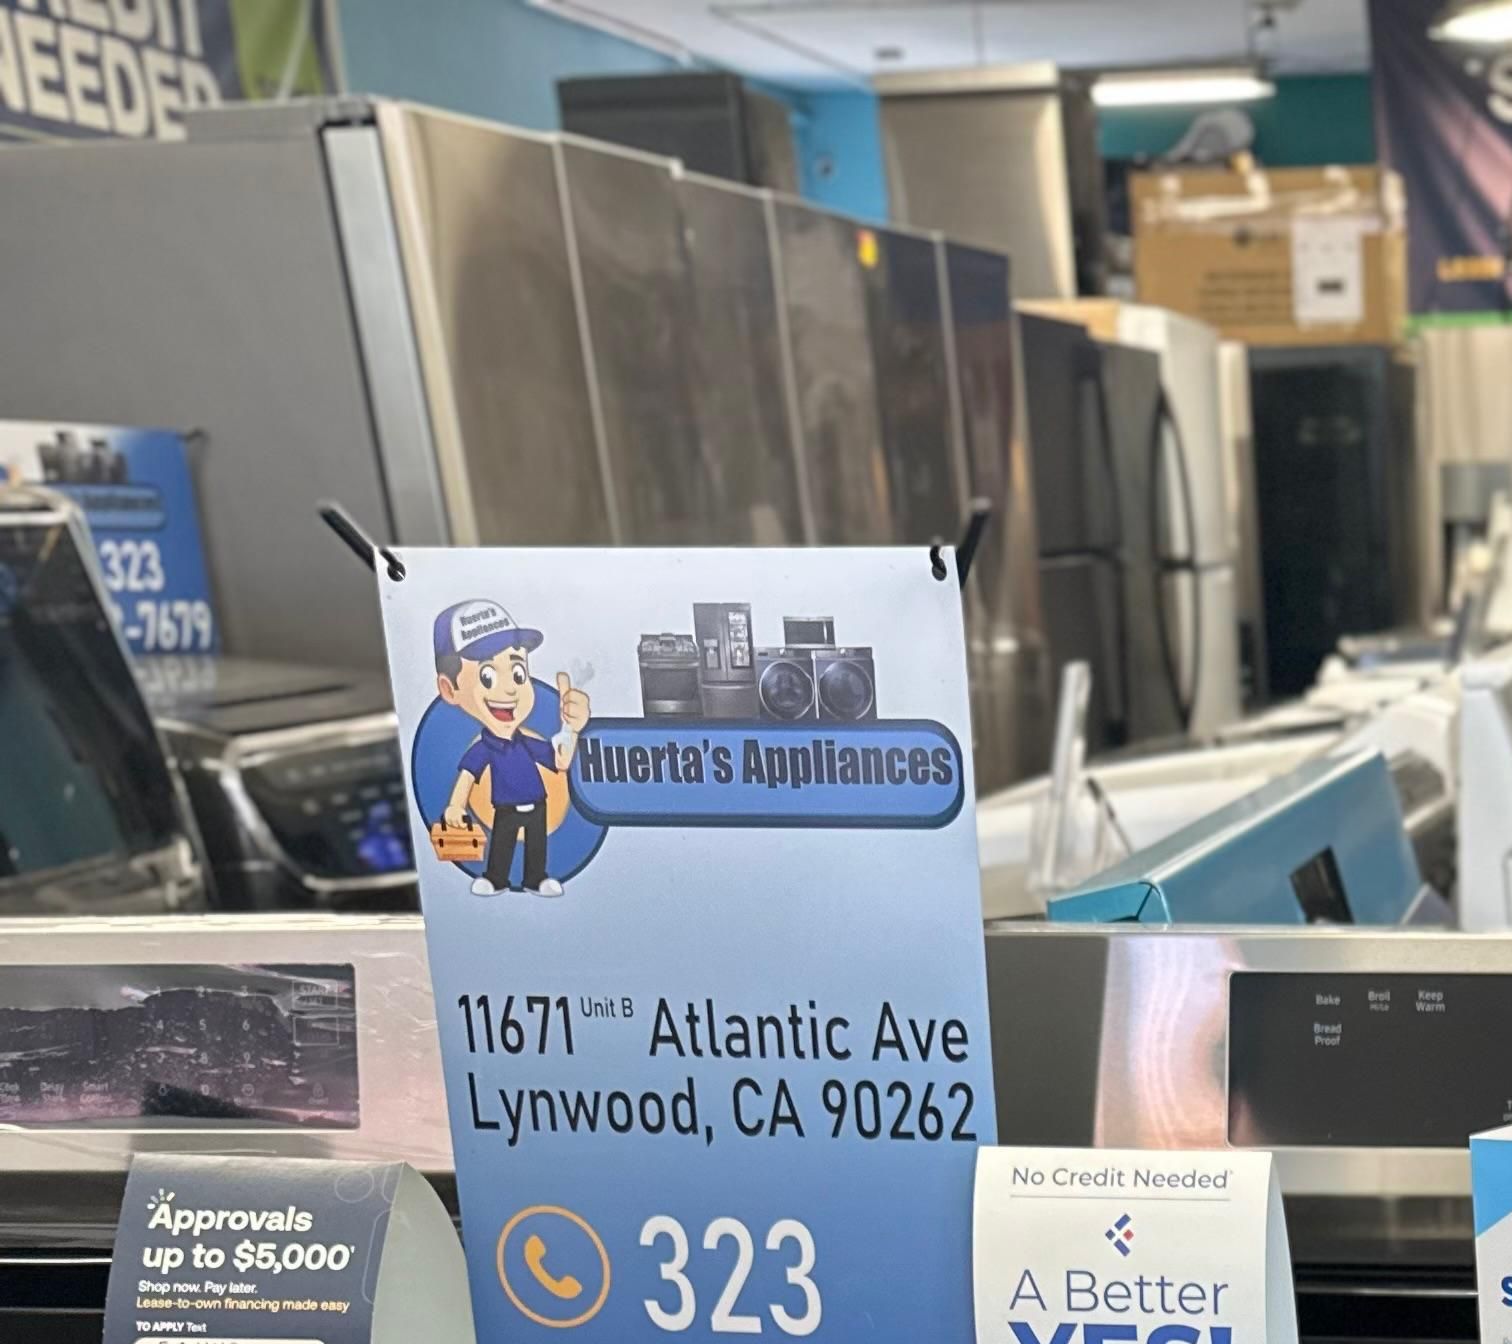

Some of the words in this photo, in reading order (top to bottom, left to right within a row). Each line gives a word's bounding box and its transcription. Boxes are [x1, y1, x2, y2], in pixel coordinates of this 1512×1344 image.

[100, 540, 165, 591] 323
[579, 737, 732, 785] Huerta's
[742, 738, 954, 789] Appliances
[457, 995, 574, 1055] 11671
[581, 997, 616, 1019] Unit
[621, 999, 634, 1018] B
[648, 999, 852, 1061] Atlantic
[871, 1001, 969, 1063] Ave
[467, 1072, 714, 1147] Lynwood,
[732, 1077, 806, 1138] CA
[821, 1079, 978, 1142] 90262
[1012, 1167, 1045, 1185] No
[1052, 1167, 1126, 1188] Credit
[148, 1203, 313, 1236] Approvals
[142, 1246, 184, 1275] up
[192, 1243, 226, 1269] to
[638, 1214, 823, 1337] 323
[136, 1296, 222, 1310] Lease-to-own
[224, 1298, 280, 1313] financing
[282, 1299, 318, 1310] made
[320, 1301, 350, 1314] easy
[138, 1280, 171, 1295] Shop
[173, 1282, 202, 1294] now.
[204, 1281, 227, 1296] Pay
[229, 1281, 258, 1294] later.
[1008, 1268, 1047, 1311] A
[1066, 1269, 1229, 1316] Better
[136, 1321, 151, 1331] TO
[152, 1322, 184, 1332] APPLY
[186, 1322, 207, 1332] Text
